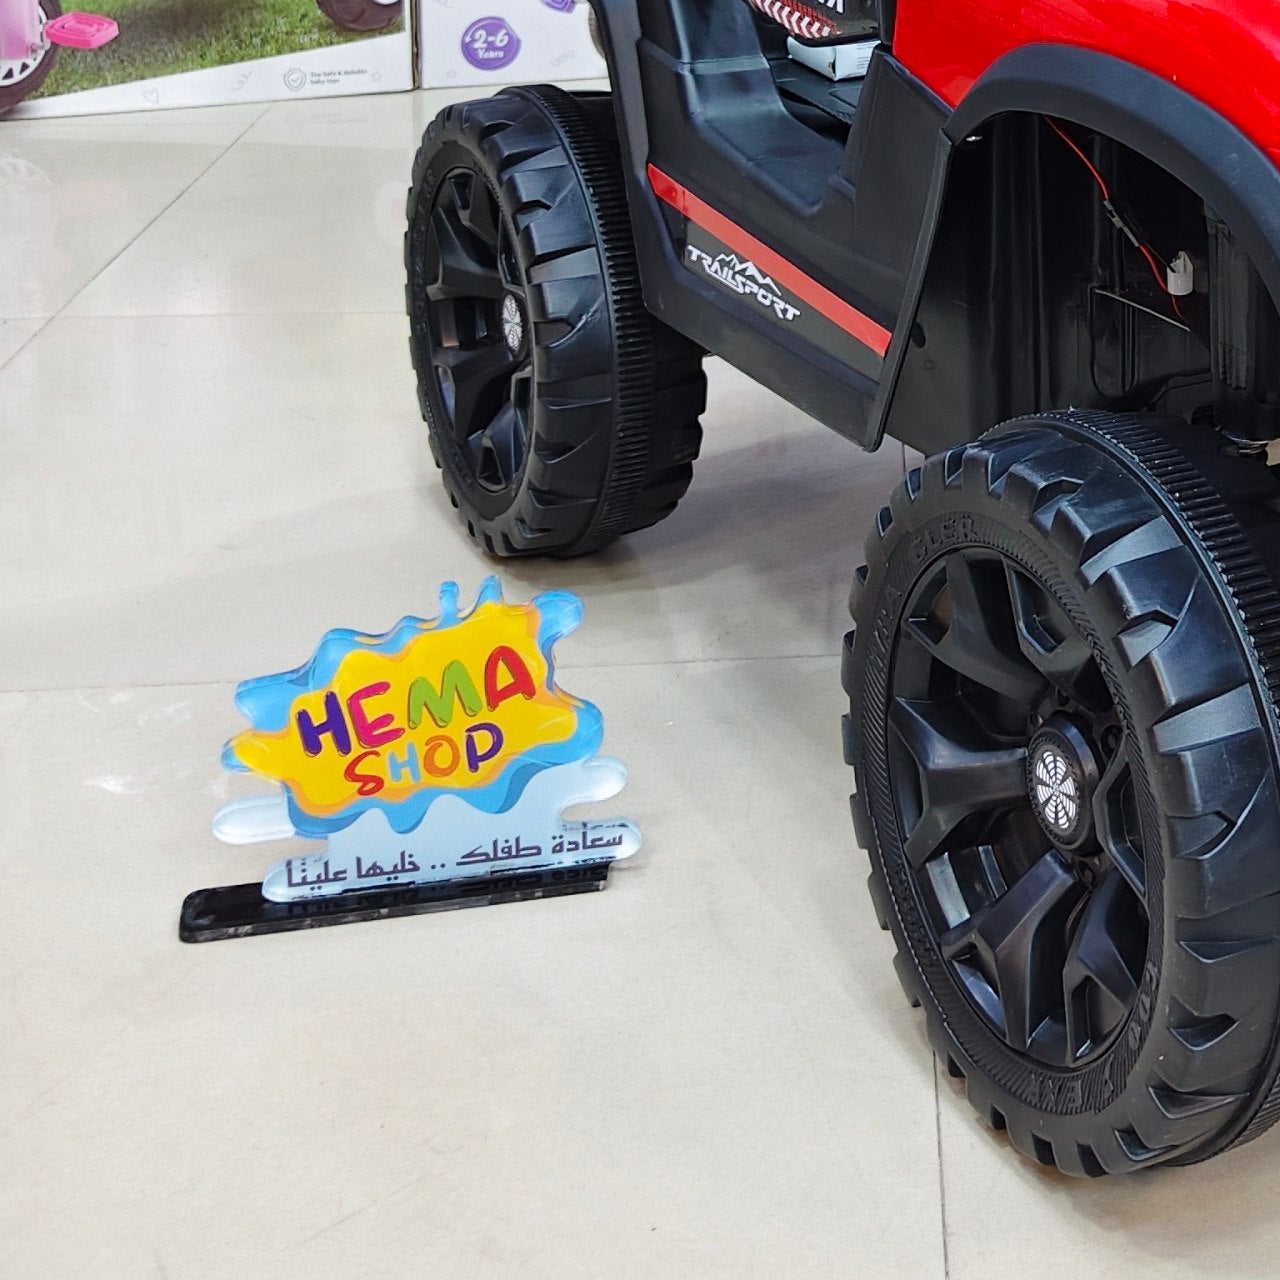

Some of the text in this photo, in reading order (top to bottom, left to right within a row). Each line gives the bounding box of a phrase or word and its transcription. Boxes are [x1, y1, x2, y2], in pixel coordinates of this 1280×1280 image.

[472, 27, 510, 50] 2-6
[477, 48, 505, 60] Years
[687, 244, 801, 321] TRAILSPORT
[296, 645, 537, 758] HEMA
[344, 721, 505, 797] SHOP
[285, 830, 624, 891] سعادة طفلك خليها علينا
